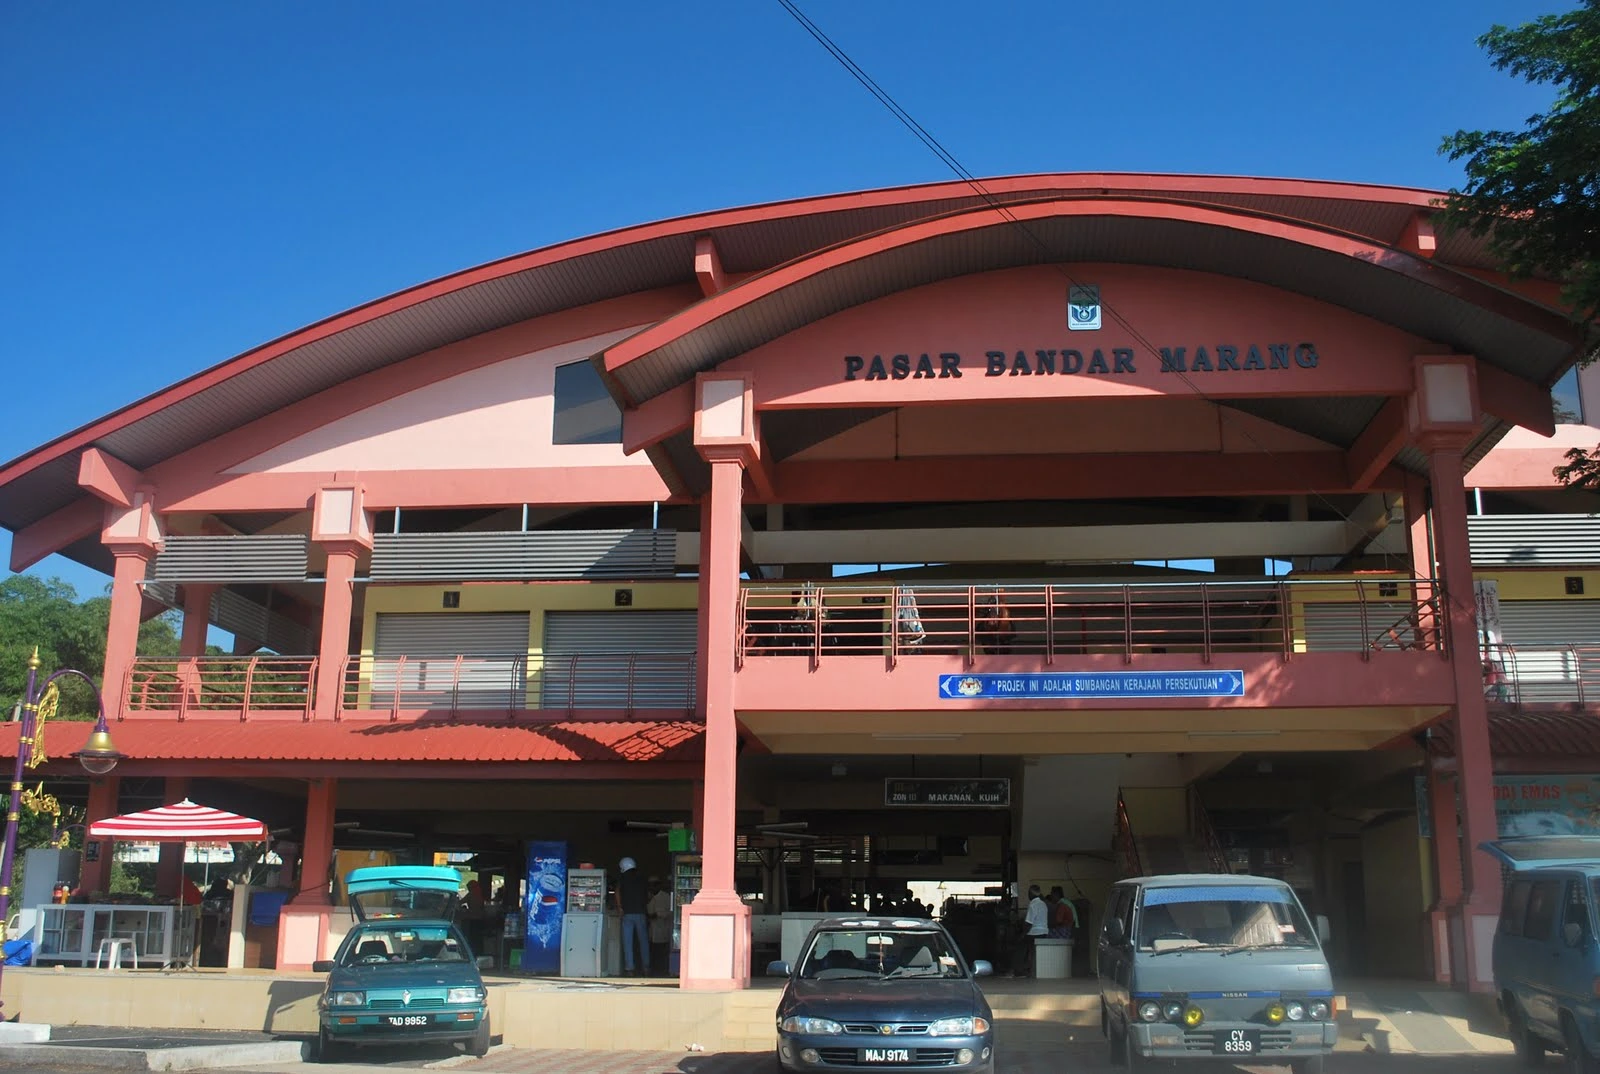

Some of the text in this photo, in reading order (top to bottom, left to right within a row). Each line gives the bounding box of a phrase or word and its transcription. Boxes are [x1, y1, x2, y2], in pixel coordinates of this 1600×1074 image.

[844, 343, 1320, 380] PASAR BANDAR MARANG
[1029, 680, 1039, 692] INI
[1043, 679, 1072, 691] ADALAH
[1075, 678, 1120, 691] SUMBANGAN
[1123, 678, 1162, 690] KERAJAAN
[892, 793, 907, 801] ZON
[979, 793, 1000, 802] KUIH
[1521, 784, 1561, 800] EMAS
[529, 888, 544, 921] PEPSI
[388, 1016, 427, 1026] TAD 9952
[1231, 1030, 1244, 1041] CY
[1224, 1040, 1252, 1052] 8359
[865, 1049, 909, 1062] MAJ 9174
